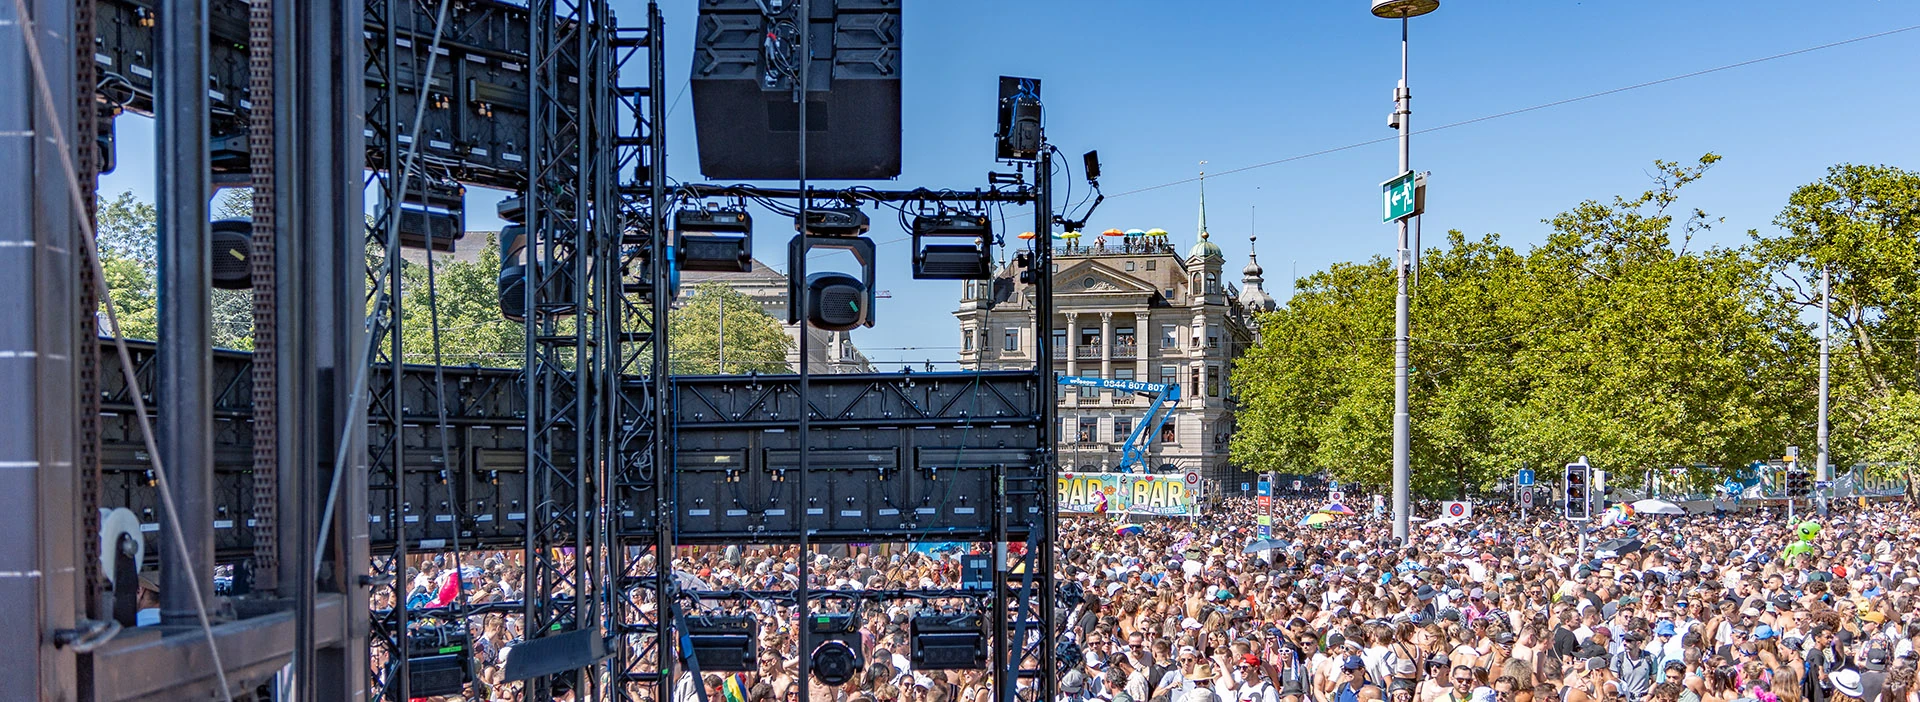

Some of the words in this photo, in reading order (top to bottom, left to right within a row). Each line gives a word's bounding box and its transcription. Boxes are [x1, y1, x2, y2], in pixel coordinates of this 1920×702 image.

[1103, 380, 1126, 388] 0844
[1128, 381, 1145, 390] 807
[1148, 383, 1165, 392] 807
[1058, 478, 1104, 505] BAR
[1133, 480, 1184, 507] BAR
